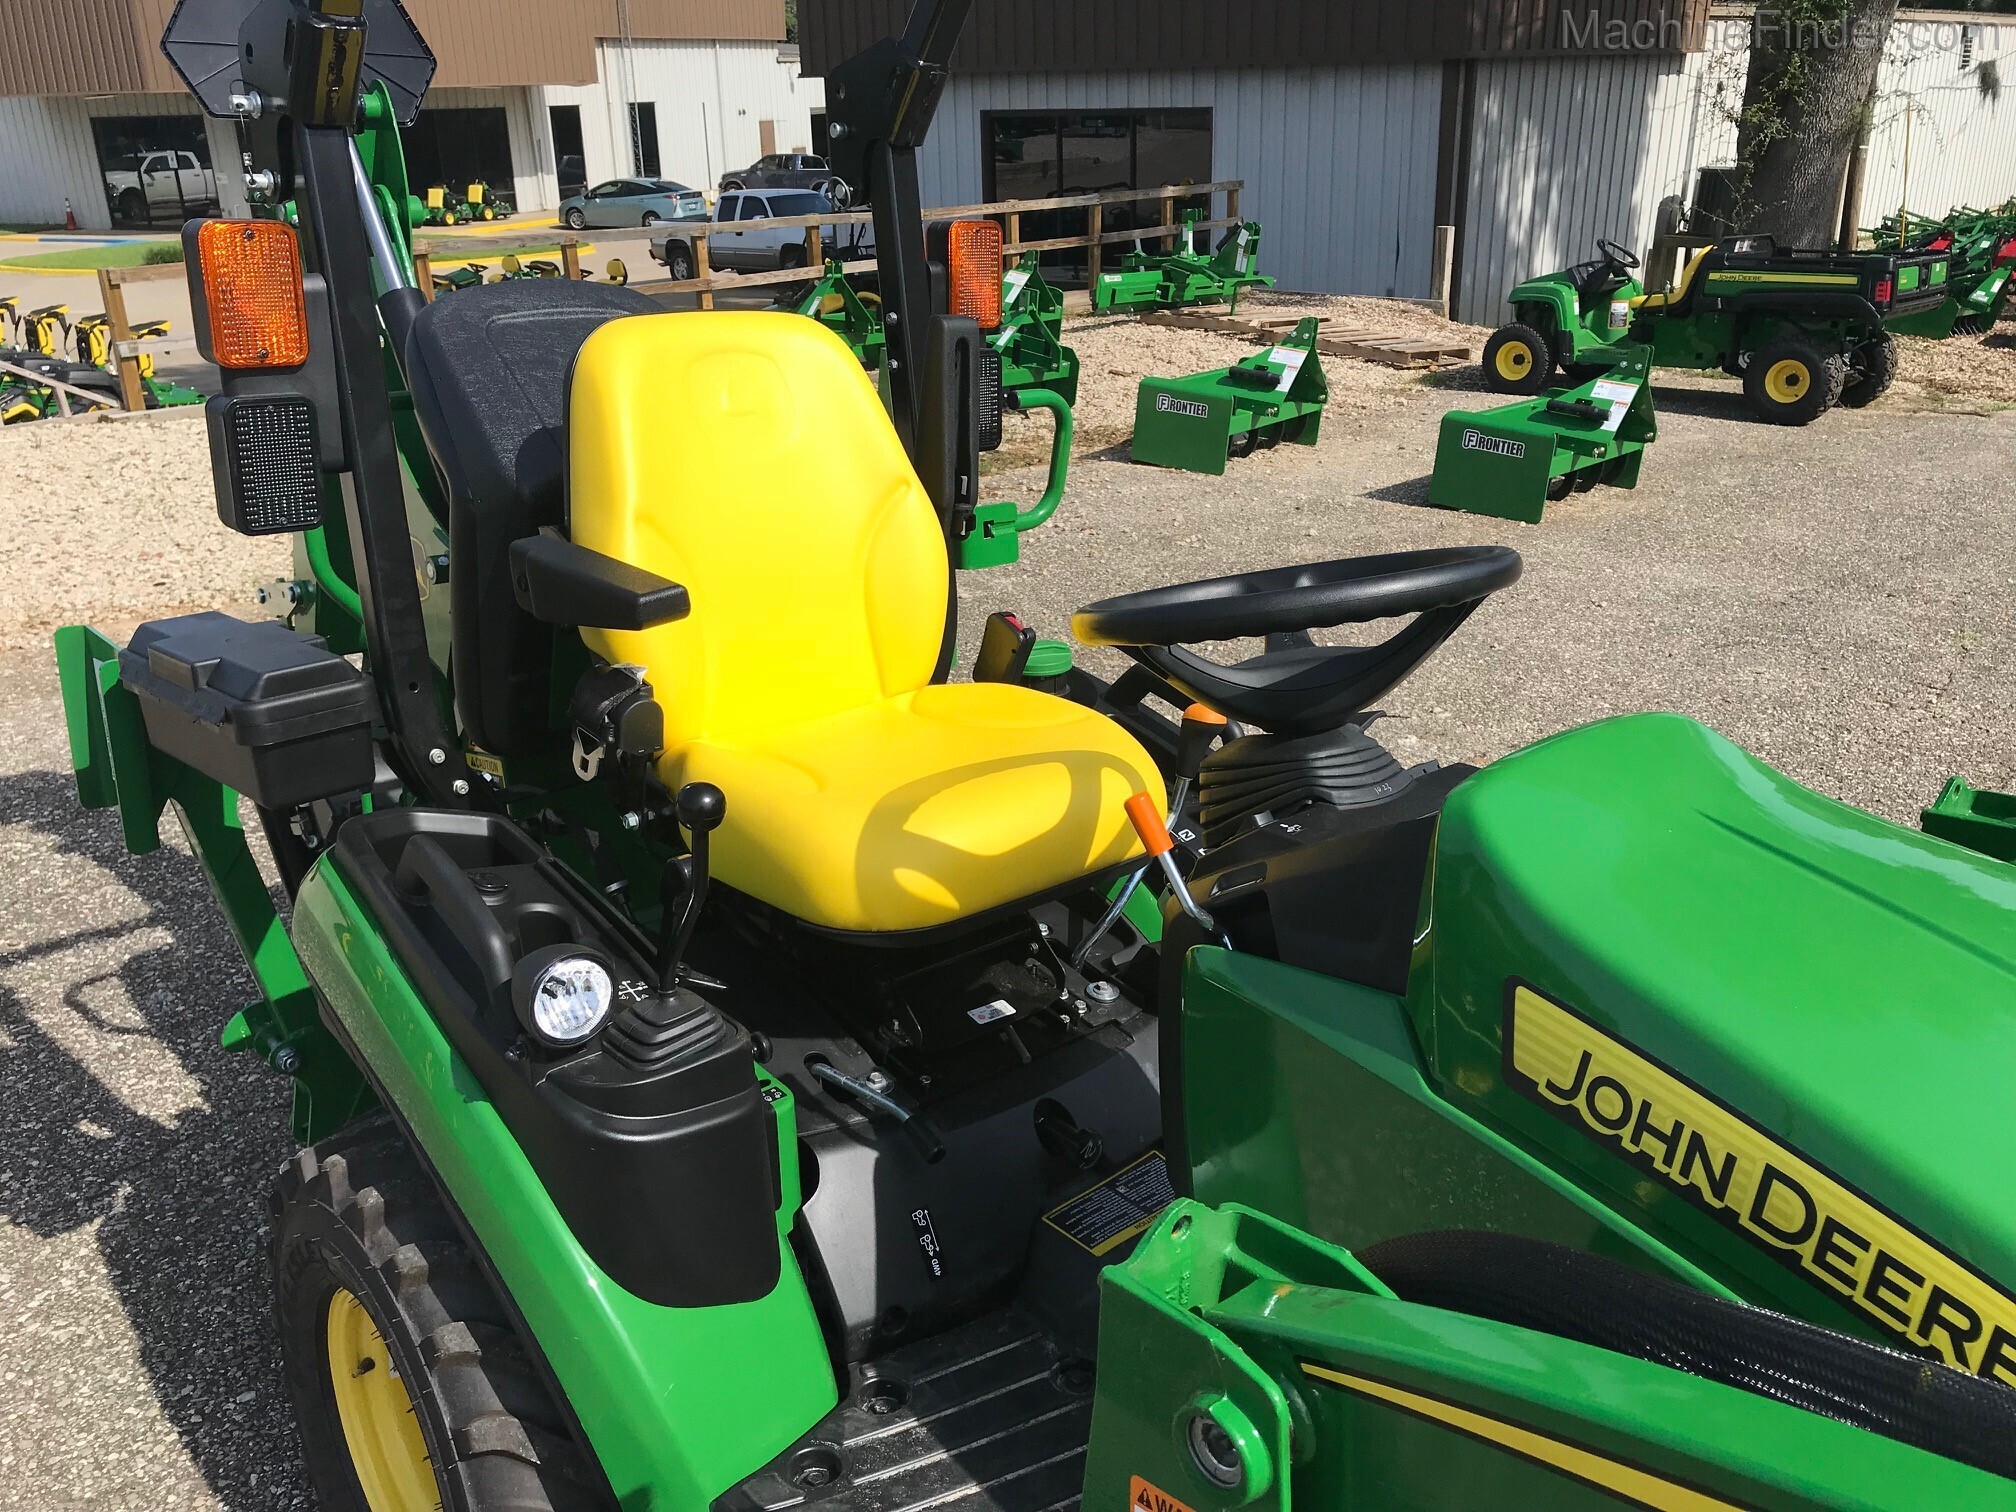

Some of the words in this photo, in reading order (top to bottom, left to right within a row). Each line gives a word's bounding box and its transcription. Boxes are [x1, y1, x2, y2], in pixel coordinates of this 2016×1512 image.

[1738, 274, 1763, 282] DEERE
[1157, 394, 1208, 417] FRONTIER
[1463, 430, 1525, 457] FRONTIER
[476, 757, 499, 772] CAUTION
[1545, 1050, 1736, 1206] JOHN
[931, 1258, 942, 1276] 4WD
